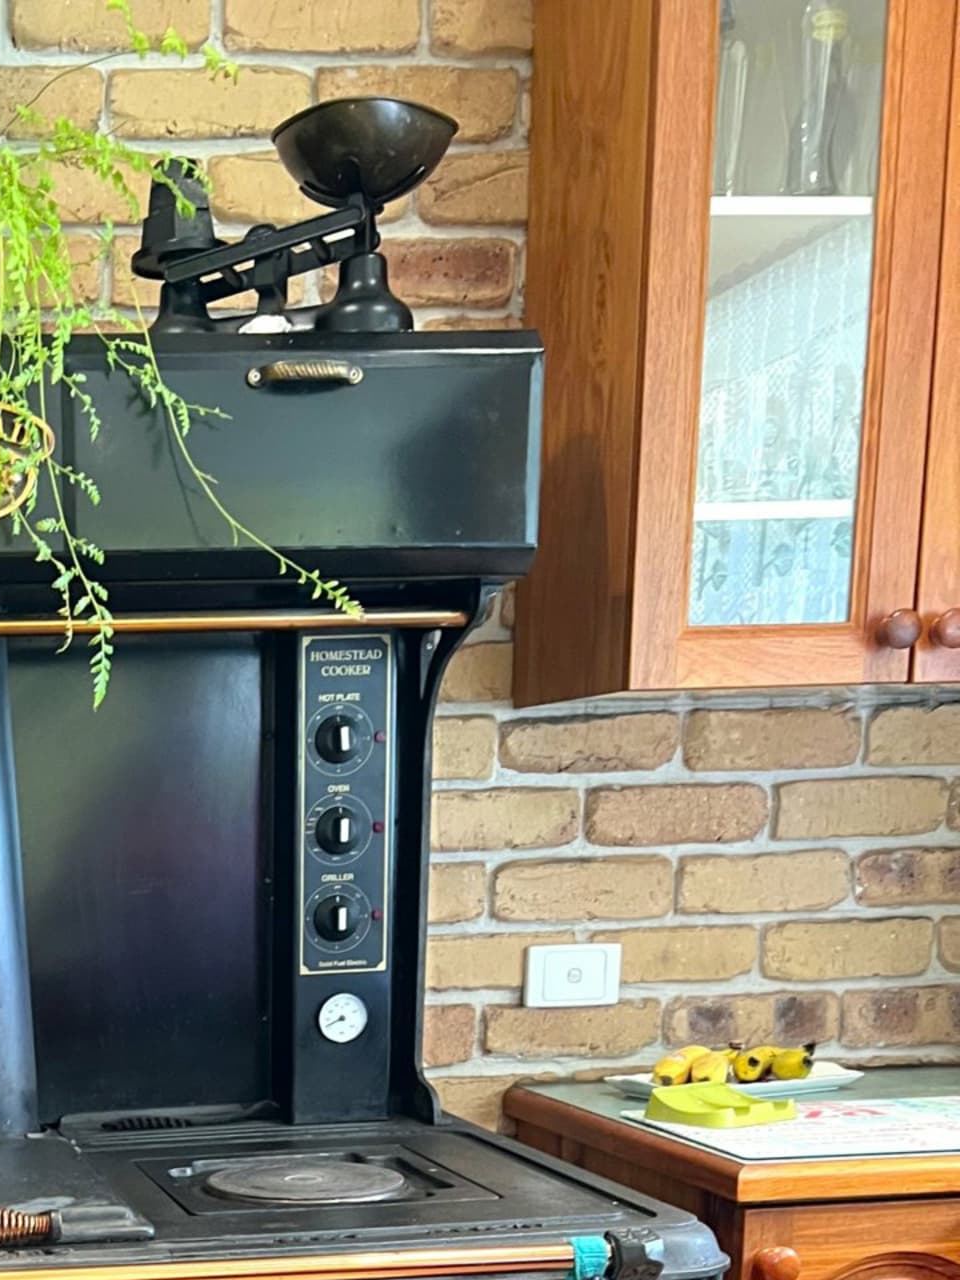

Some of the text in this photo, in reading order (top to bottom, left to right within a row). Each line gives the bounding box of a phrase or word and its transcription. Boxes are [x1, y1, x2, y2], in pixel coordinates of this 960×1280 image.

[310, 649, 383, 662] HOMESTEAD
[320, 664, 372, 677] COOKER
[318, 692, 361, 703] HOT PLATE
[327, 784, 351, 793] OVEN
[320, 872, 355, 883] GRILLER
